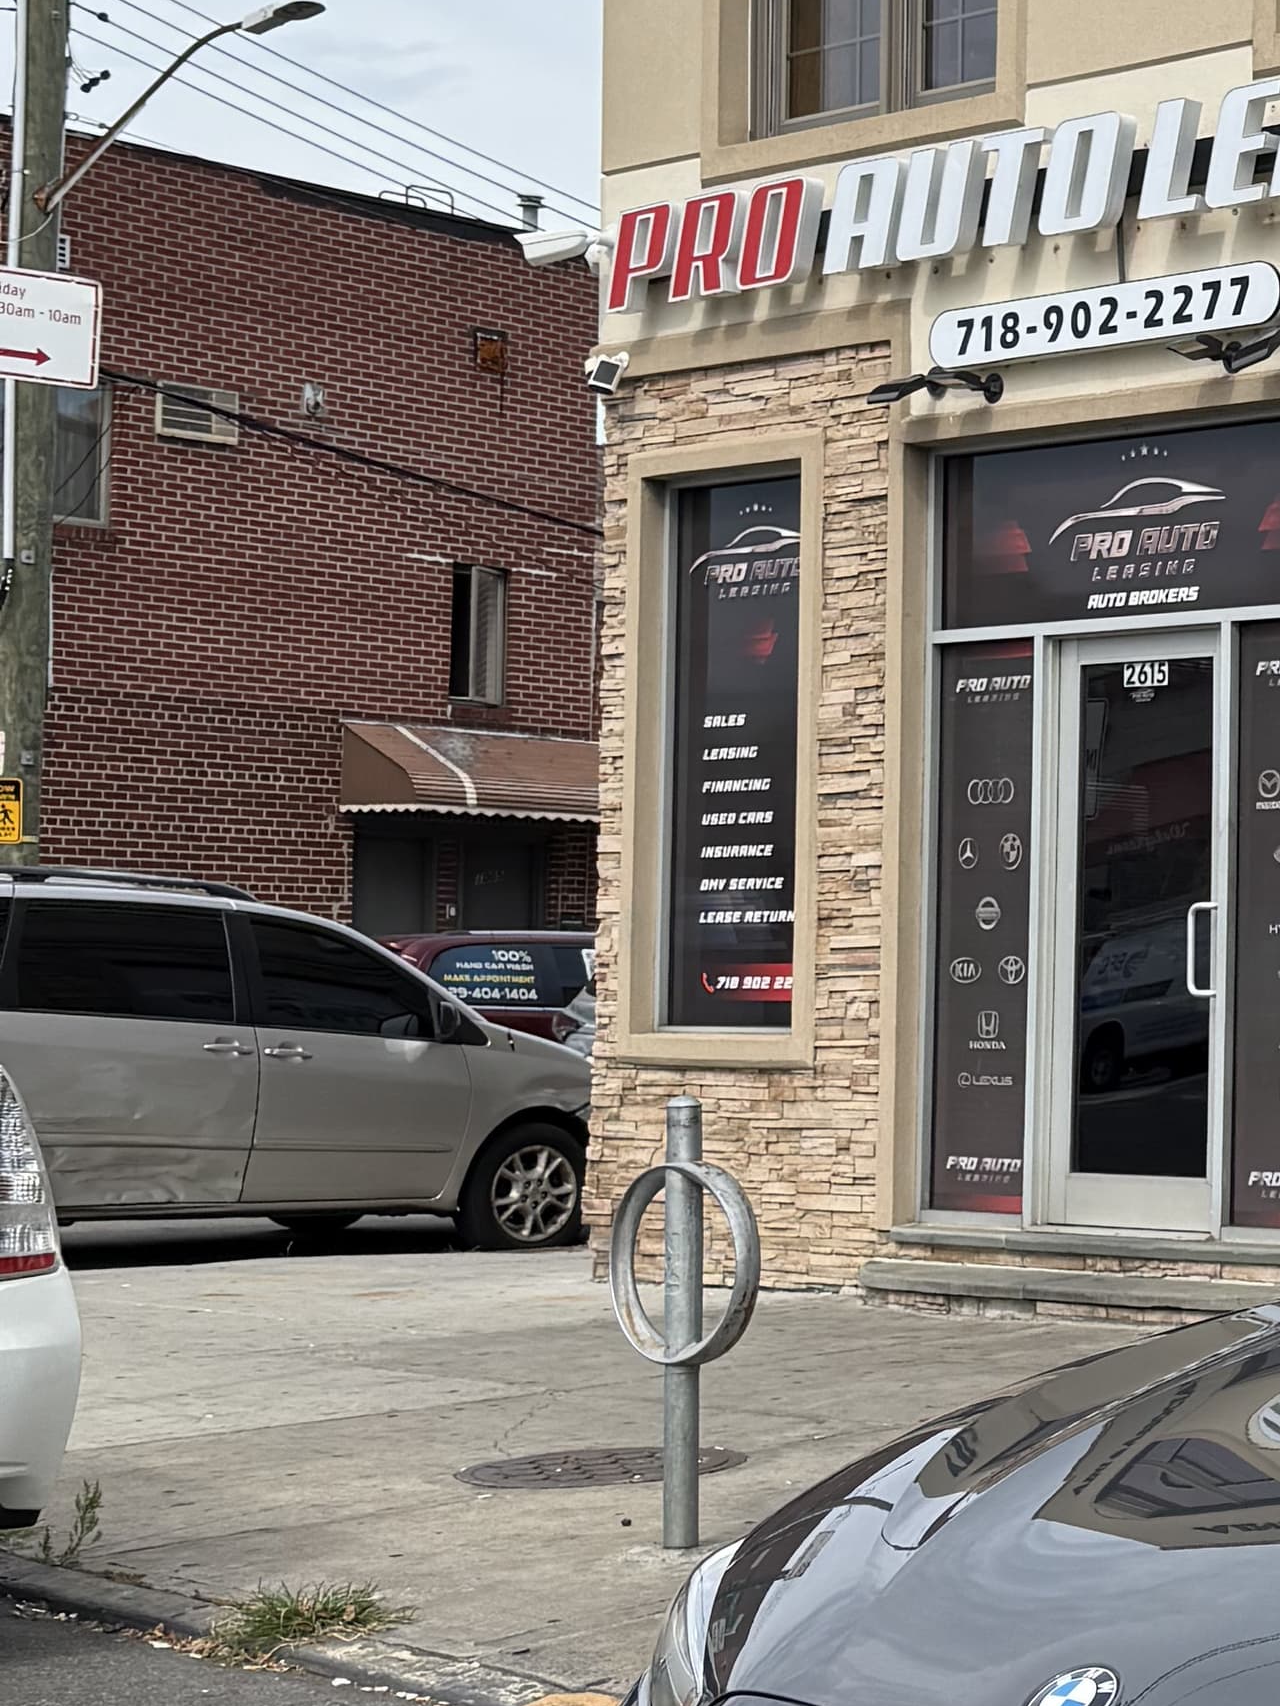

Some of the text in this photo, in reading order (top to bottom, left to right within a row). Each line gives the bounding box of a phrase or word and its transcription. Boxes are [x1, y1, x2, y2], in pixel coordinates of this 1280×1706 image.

[606, 174, 825, 314] PRO
[821, 110, 1138, 275] AUTO
[48, 309, 81, 325] 10am
[955, 276, 1252, 355] 718-902-2277
[1070, 521, 1220, 562] PRO AUTO
[704, 562, 748, 585] PRO
[1092, 559, 1196, 582] LEASING
[718, 582, 791, 599] LEASING
[1087, 586, 1200, 610] AUTO BROKERS
[1125, 662, 1166, 685] 2615
[956, 675, 1031, 693] PRO AUTO
[703, 714, 746, 728] SALES
[702, 746, 758, 760] LEASING
[702, 778, 771, 793] FINANCING
[701, 811, 773, 825] USED CARS
[701, 845, 774, 858] INSURANCE
[700, 877, 784, 891] DMV SERVICE
[699, 911, 741, 924] LEASE
[491, 949, 532, 963] 100%
[506, 963, 534, 971] WASH
[443, 974, 470, 982] MAKE
[716, 975, 793, 989] 718 902 22
[447, 987, 538, 1000] 29-404-1404
[969, 1040, 1006, 1050] HONDA
[972, 1075, 1013, 1086] LEXUS
[946, 1156, 1022, 1173] PRO AUTO
